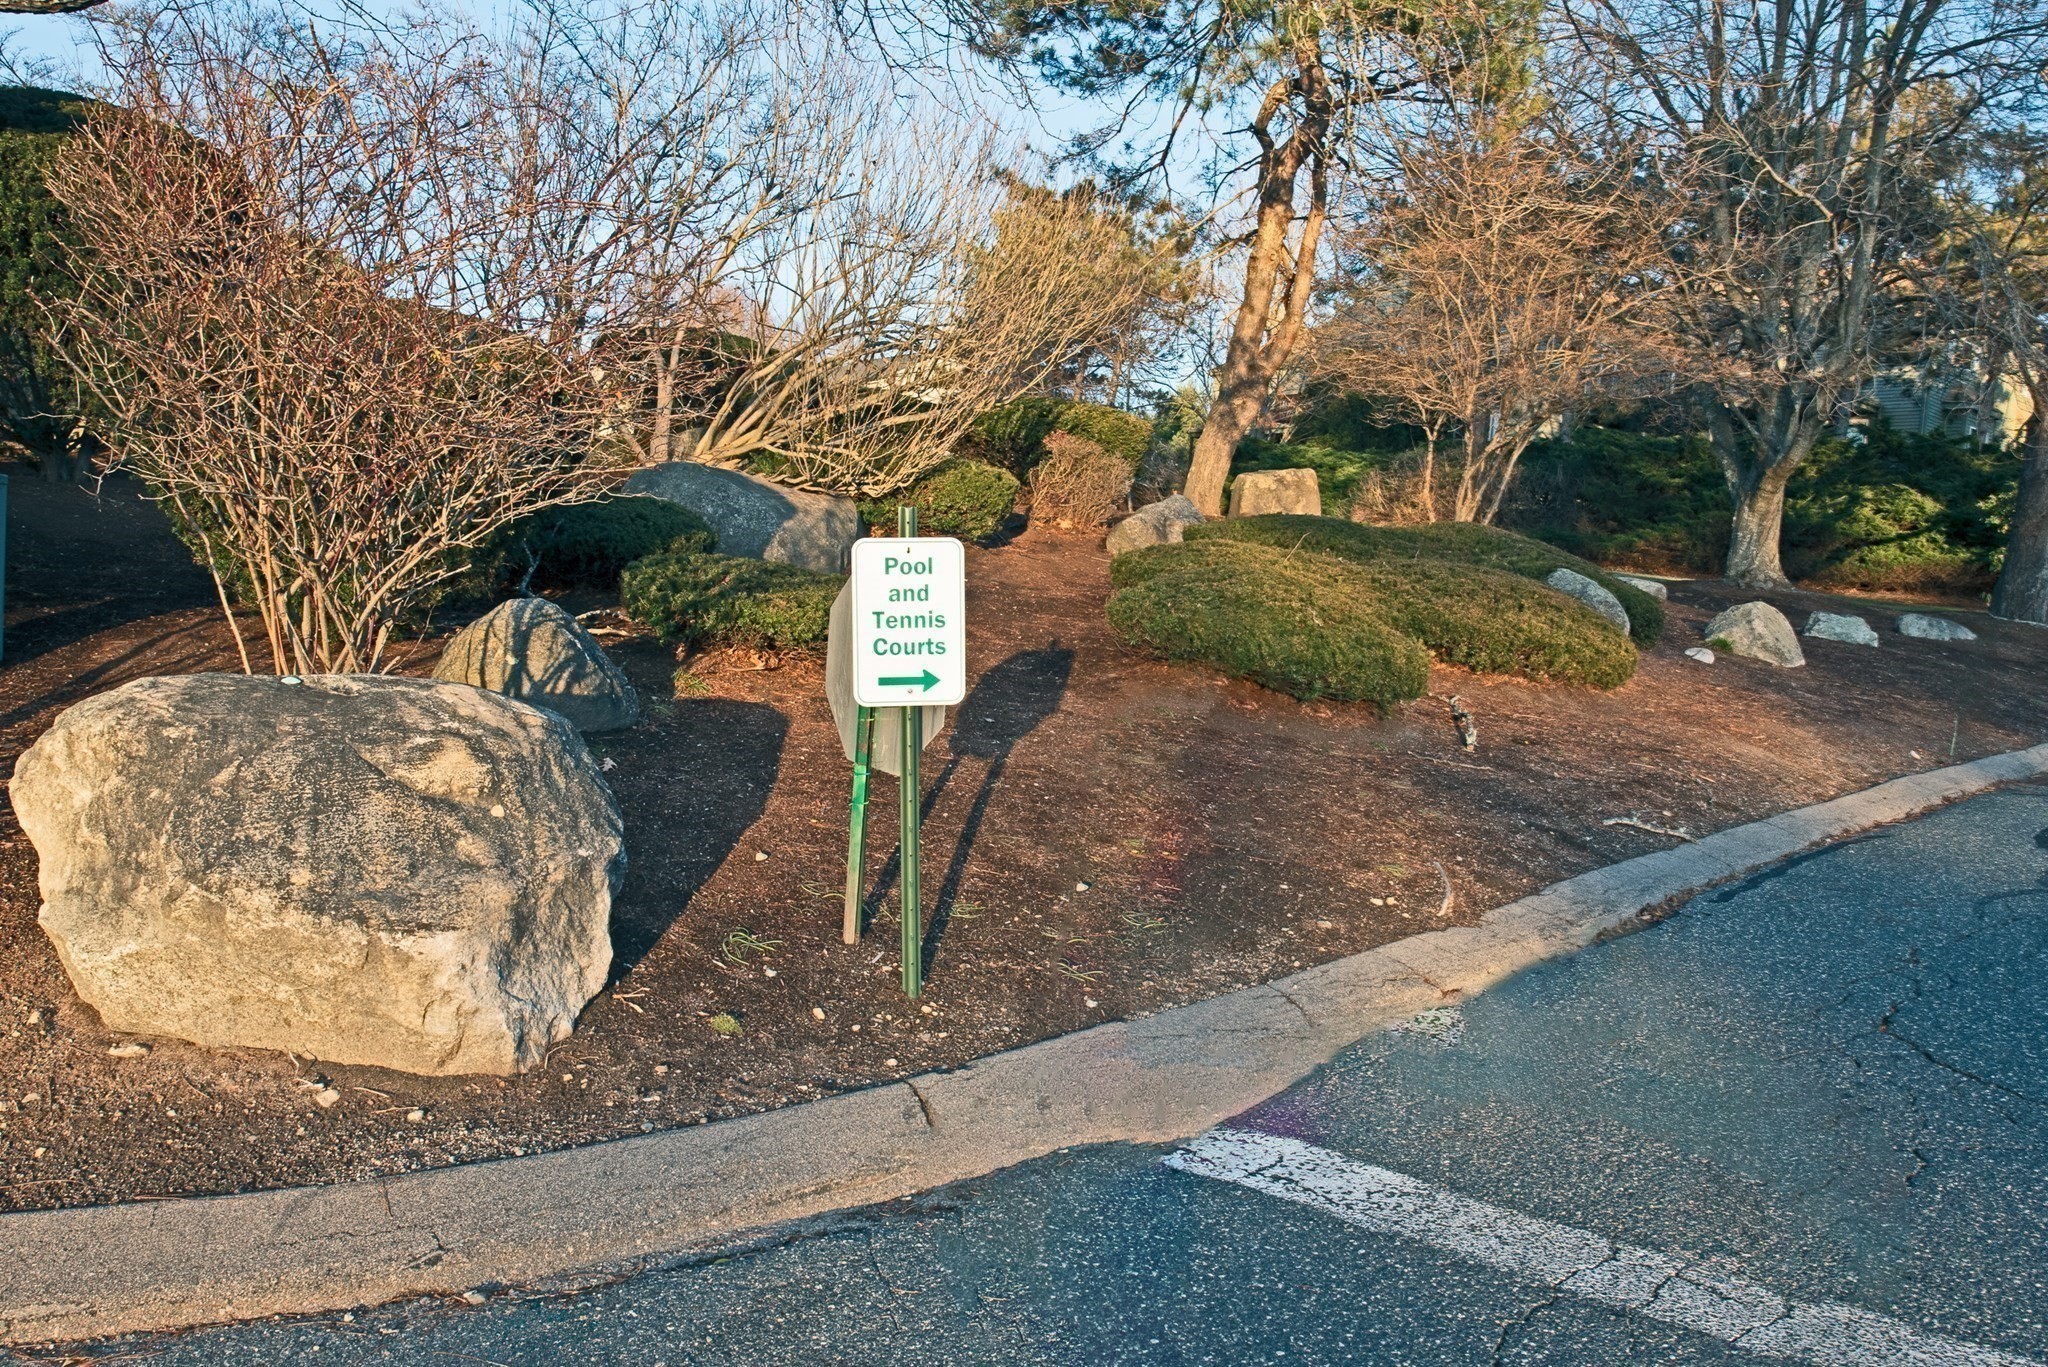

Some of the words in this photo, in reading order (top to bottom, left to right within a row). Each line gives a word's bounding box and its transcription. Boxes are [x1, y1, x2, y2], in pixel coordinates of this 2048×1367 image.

[884, 557, 933, 575] Pool
[888, 584, 929, 602] and
[871, 610, 946, 629] Tennis
[872, 637, 947, 656] Courts
